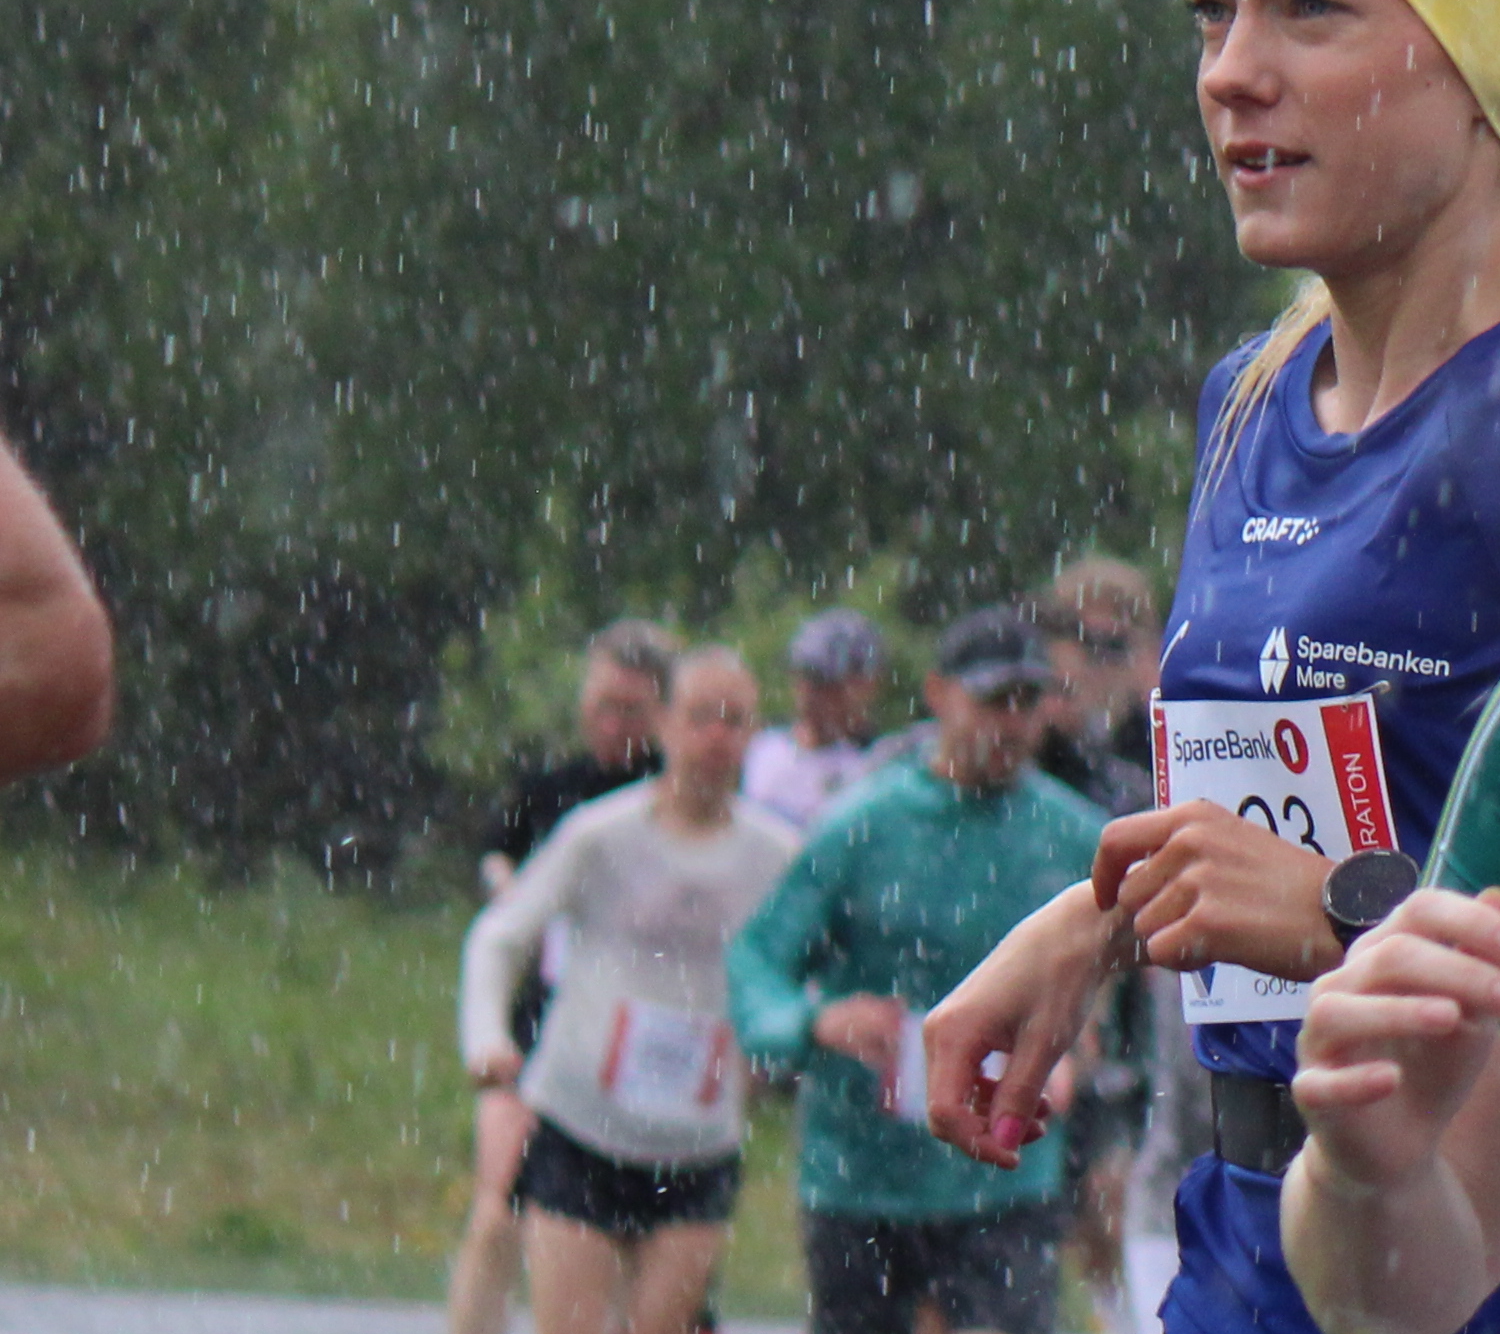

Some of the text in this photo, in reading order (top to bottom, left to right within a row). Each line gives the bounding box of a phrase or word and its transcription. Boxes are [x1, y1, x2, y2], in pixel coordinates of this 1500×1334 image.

[1242, 516, 1304, 544] CRAFT
[1297, 635, 1451, 677] Sparebanken
[1297, 665, 1346, 689] Møre
[1174, 730, 1276, 766] SpareBank
